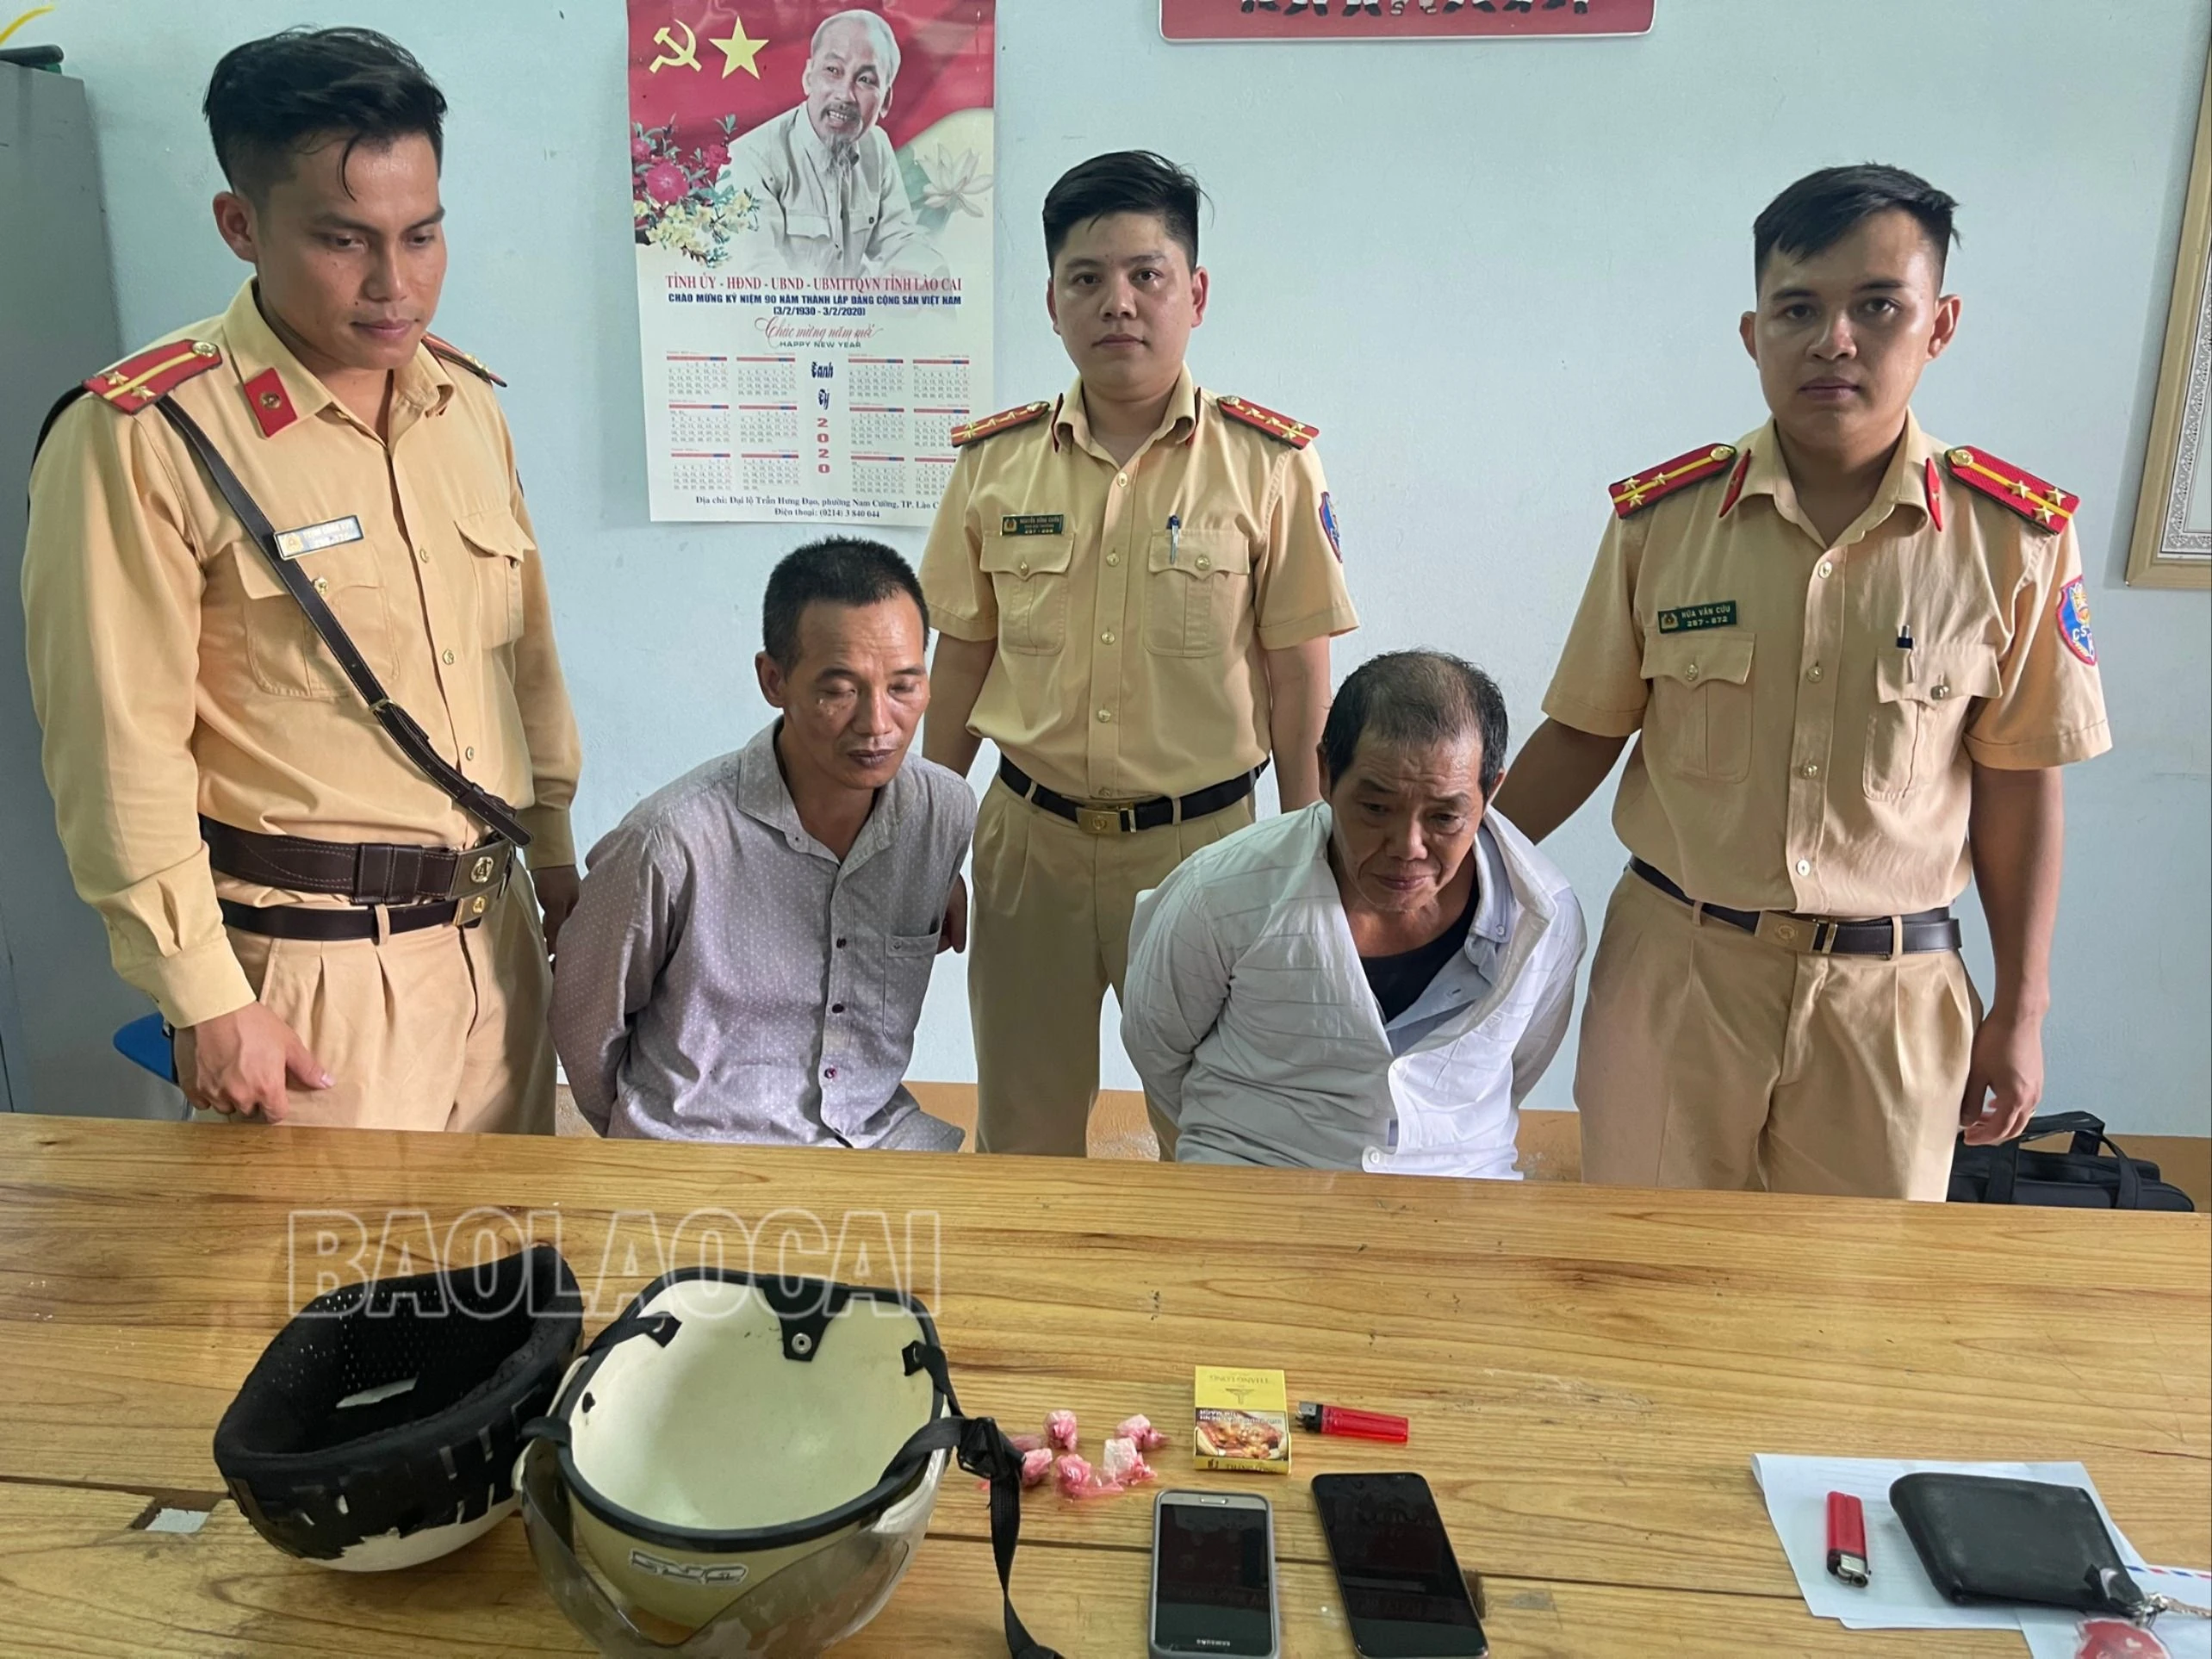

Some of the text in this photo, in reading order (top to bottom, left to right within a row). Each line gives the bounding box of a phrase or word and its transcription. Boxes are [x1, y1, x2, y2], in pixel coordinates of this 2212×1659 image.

[666, 271, 696, 289] TỈNH
[700, 272, 716, 289] ỦY
[727, 276, 761, 289] HĐND
[772, 277, 804, 290] UBND
[814, 277, 880, 293] UBMTTQVN
[883, 274, 910, 290] TỈNH
[915, 275, 938, 290] LÀO
[941, 277, 961, 290] CAI
[668, 293, 693, 302] CHÀO
[696, 293, 723, 303] MỪNG
[740, 295, 761, 305] NIỆM
[780, 295, 798, 304] NĂM
[802, 295, 830, 304] THÀNH
[833, 295, 848, 305] LẬP
[877, 295, 900, 306] CỘNG
[903, 295, 919, 305] SẢN
[921, 295, 940, 307] VIỆT
[943, 295, 961, 305] NAM
[774, 307, 816, 315] (3/2/1930
[823, 308, 866, 316] 3/2/2020)
[778, 497, 800, 506] Hưng
[853, 499, 871, 507] Nam
[916, 500, 931, 509] Lào
